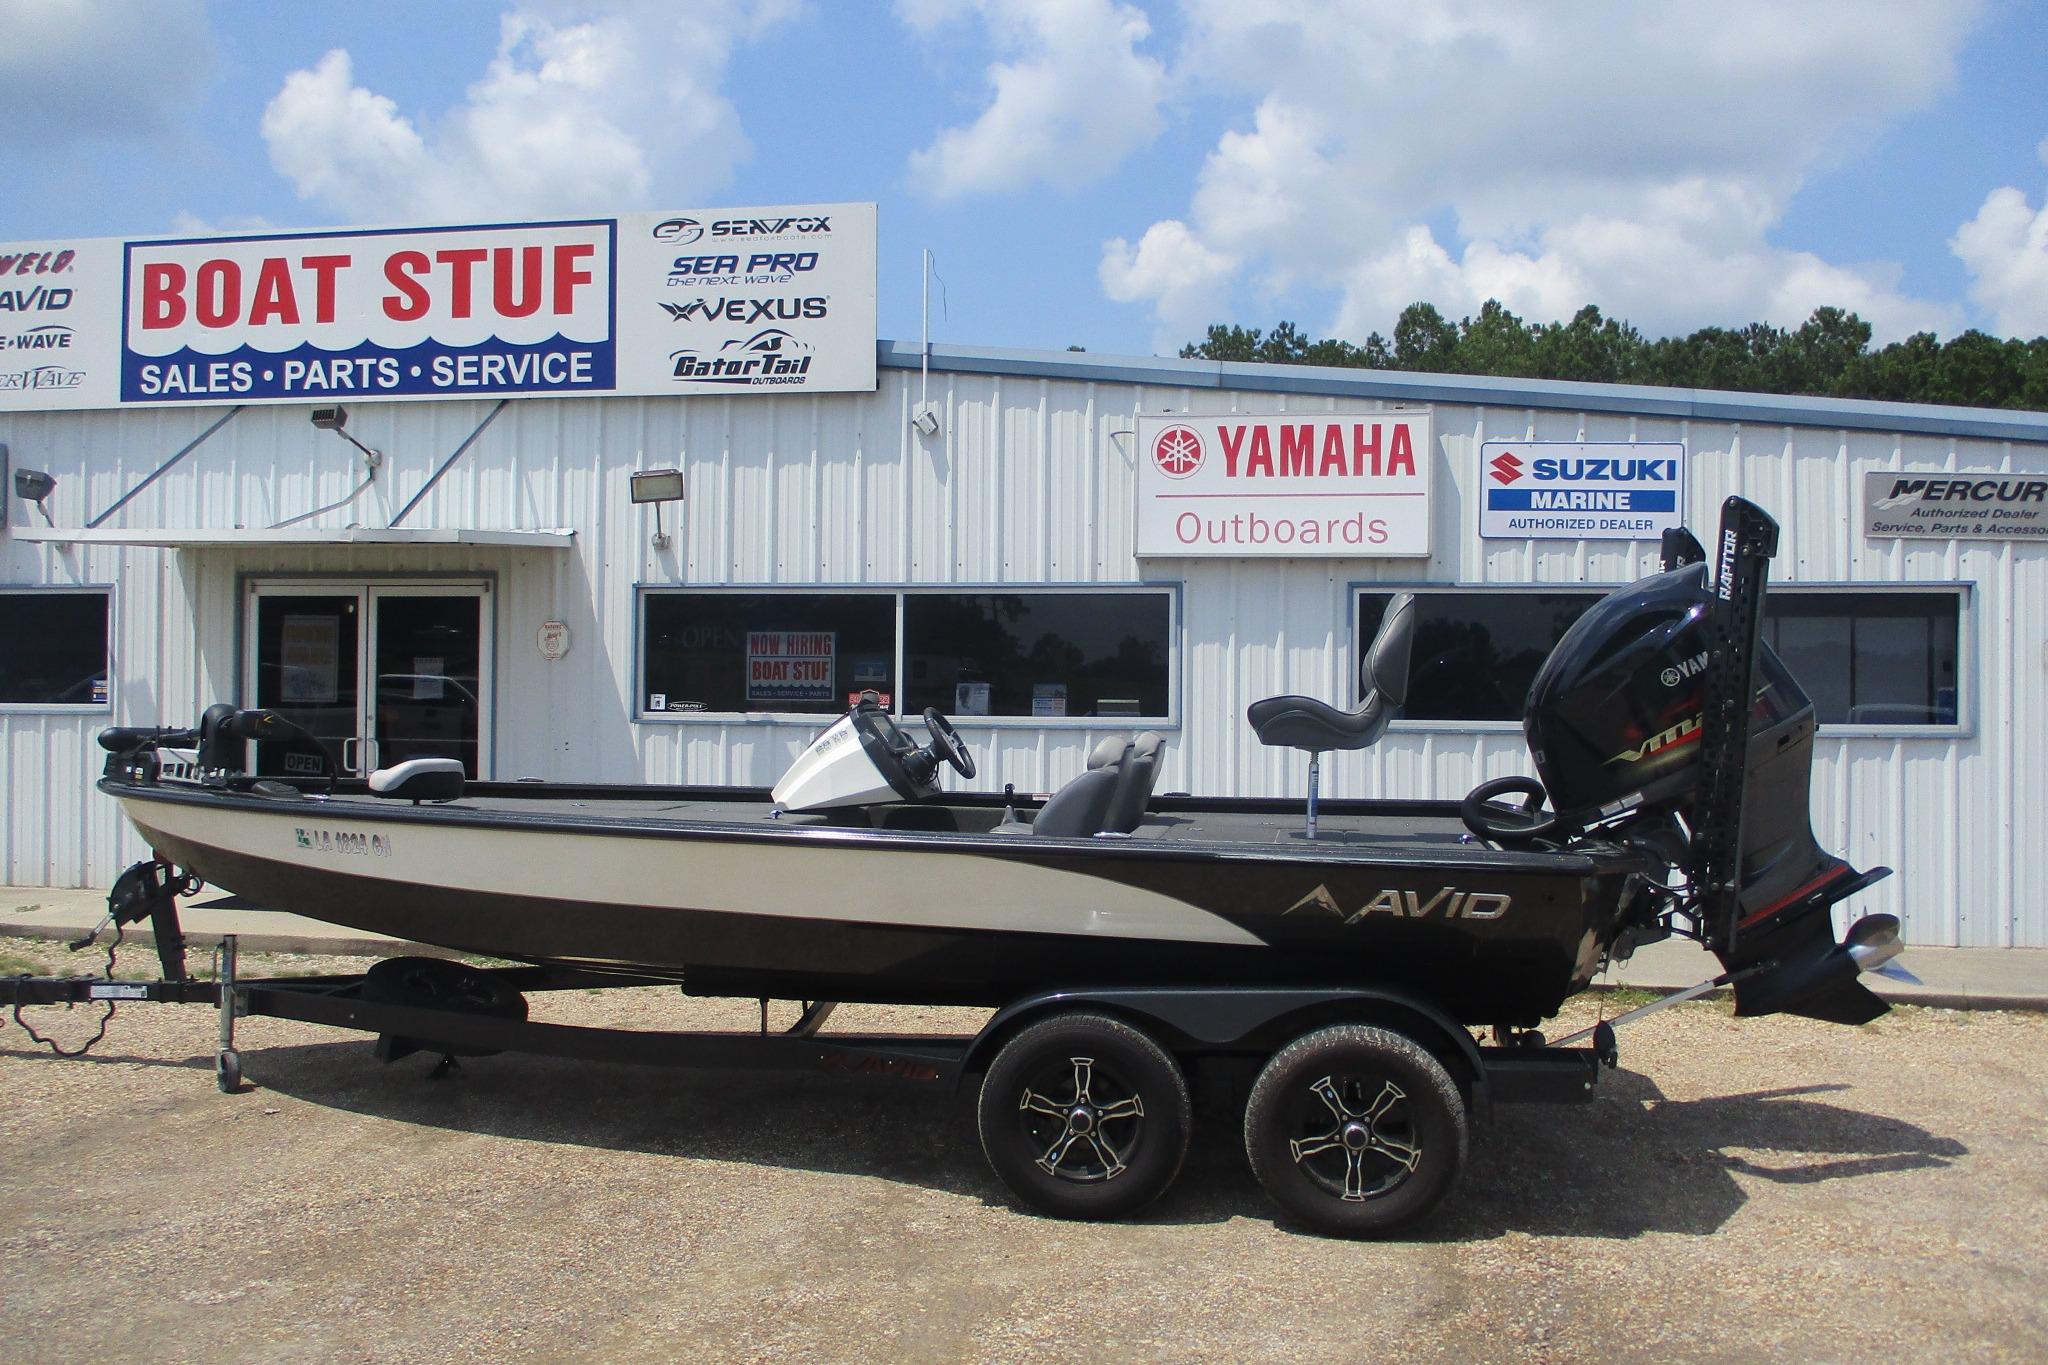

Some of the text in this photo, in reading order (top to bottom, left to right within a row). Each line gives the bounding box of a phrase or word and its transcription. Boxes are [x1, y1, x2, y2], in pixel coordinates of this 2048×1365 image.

[668, 252, 819, 277] SEA PRO
[142, 244, 595, 330] BOAT STUF
[667, 274, 792, 287] the next wave
[696, 297, 827, 324] VEXUS
[140, 352, 593, 394] SALES PARTS SERVICE
[752, 376, 806, 385] OUTBOARDS
[1217, 424, 1416, 477] YAMAHA
[1532, 459, 1676, 481] SUZUKI
[1530, 491, 1631, 510] MARINE
[1888, 480, 2048, 502] MERCUR
[1910, 507, 2040, 519] Authorized Dealer
[1175, 512, 1389, 544] Outboards
[1508, 519, 1653, 530] AUTHORIZED DEALER
[1871, 522, 1926, 533] Service,
[1931, 523, 1968, 533] Parts
[1972, 524, 1982, 534] &
[1719, 529, 1738, 601] RAPTOR
[750, 634, 832, 656] NOW HIRING
[752, 661, 829, 680] BOAT STUF
[1676, 650, 1709, 679] YAM
[287, 755, 321, 771] OPEN
[1344, 886, 1512, 925] AVID
